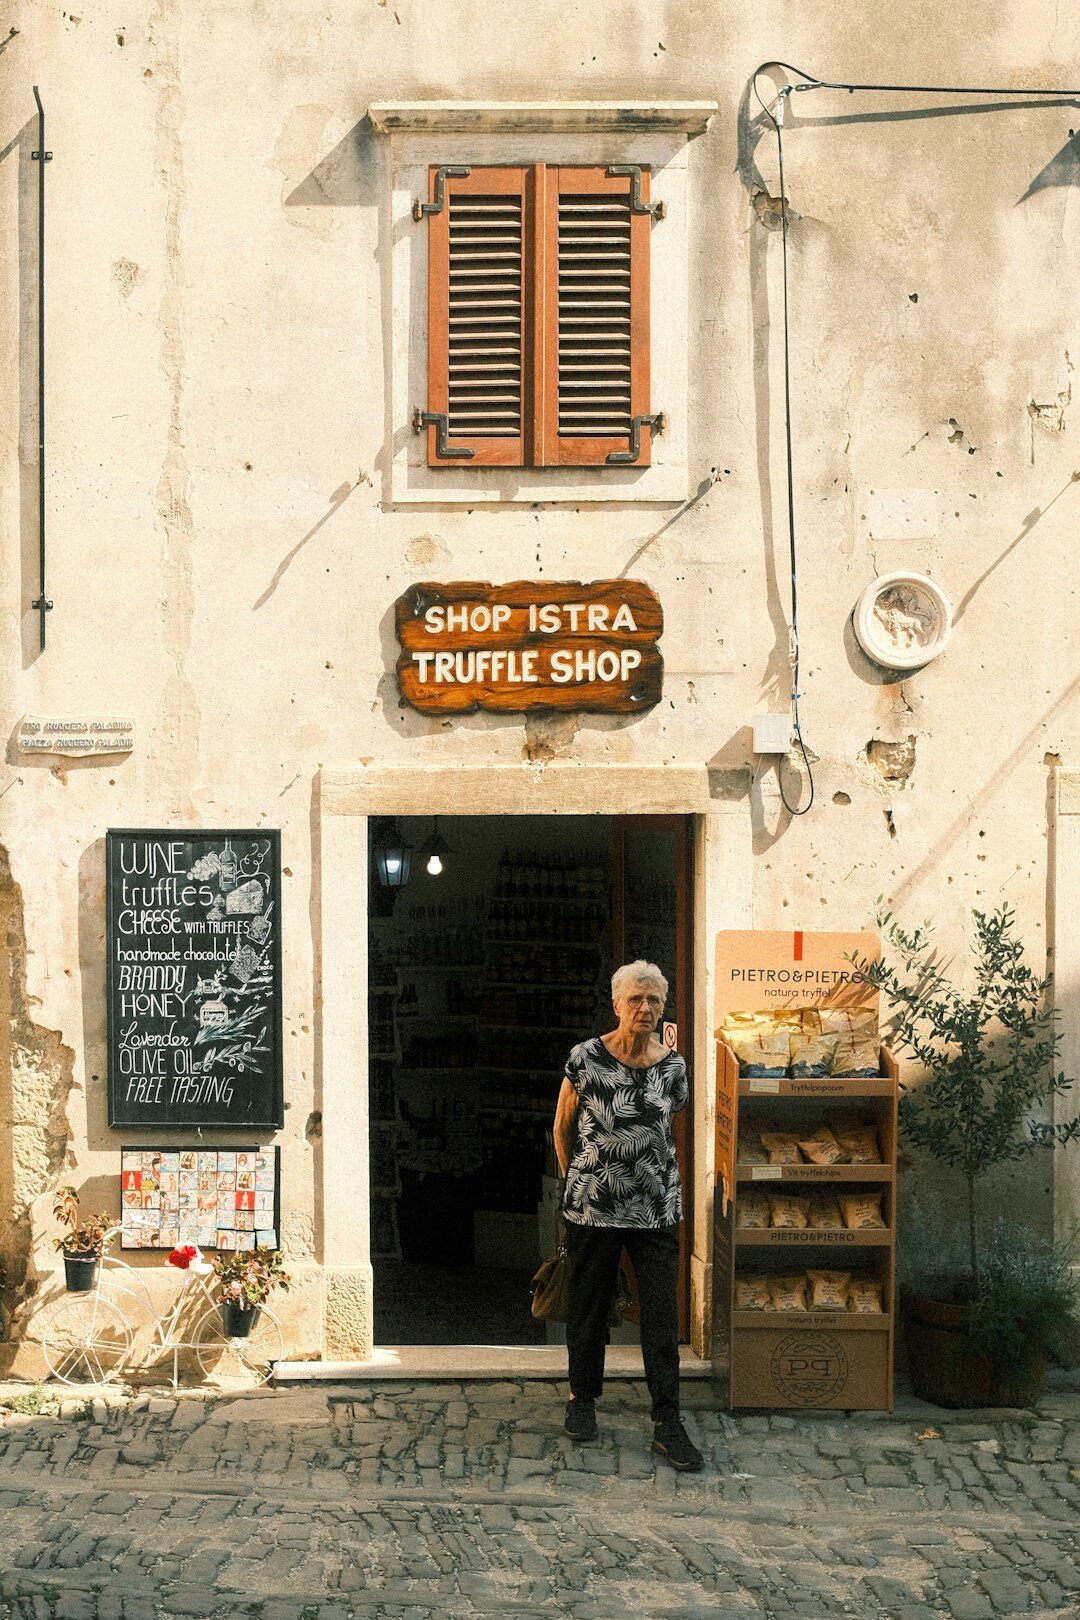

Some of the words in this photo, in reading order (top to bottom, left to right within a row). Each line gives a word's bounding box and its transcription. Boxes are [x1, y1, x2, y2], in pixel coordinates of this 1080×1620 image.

[424, 604, 512, 634] SHOP
[529, 604, 638, 634] ISTRA
[411, 650, 539, 684] TRUFFLE
[550, 649, 642, 683] SHOP
[120, 842, 187, 878] WINE
[122, 878, 214, 907] truffles
[118, 909, 182, 935] CHEESE
[184, 921, 205, 934] WITH
[207, 921, 250, 934] TRUFFLES
[117, 937, 181, 961] handmade
[184, 937, 236, 961] chocolate
[118, 965, 188, 993] BRANDY
[730, 968, 863, 984] PIETRO&PIETRO
[121, 992, 194, 1018] HONEY
[764, 988, 799, 997] natura
[802, 987, 831, 1000] tryffel
[119, 1020, 191, 1050] Lavender
[119, 1049, 167, 1075] OLIVE
[174, 1049, 202, 1075] OIL
[126, 1077, 166, 1104] FREE
[171, 1076, 236, 1108] TASTING
[790, 1083, 844, 1093] Tryffelpopcorn
[771, 1232, 855, 1242] PIETRO&PIETRO
[787, 1316, 812, 1325] natura
